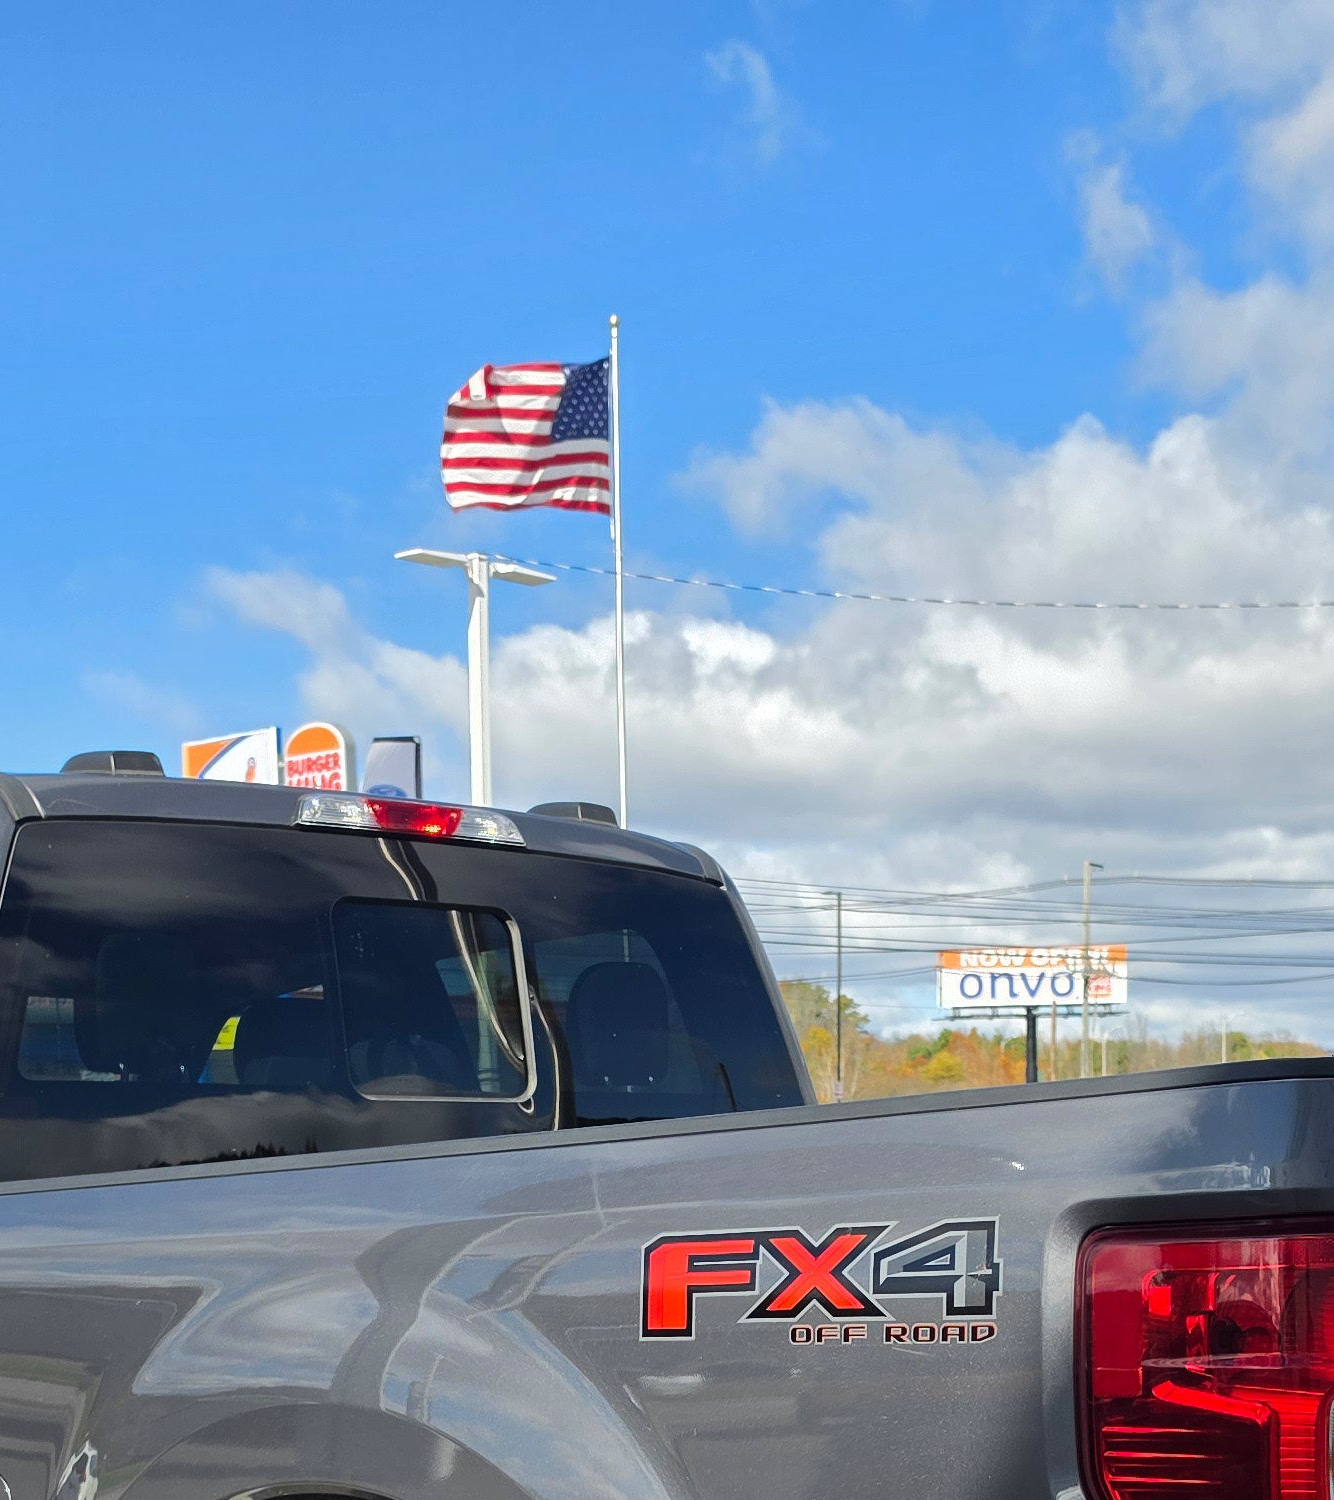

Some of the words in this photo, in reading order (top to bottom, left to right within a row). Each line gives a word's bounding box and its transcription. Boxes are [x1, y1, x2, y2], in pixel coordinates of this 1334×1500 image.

[286, 752, 342, 776] BURGER
[960, 948, 1027, 967] NOW
[959, 971, 1075, 999] onvo
[639, 1215, 1004, 1342] FX4
[788, 1323, 868, 1346] OFF
[882, 1321, 998, 1346] ROAD
